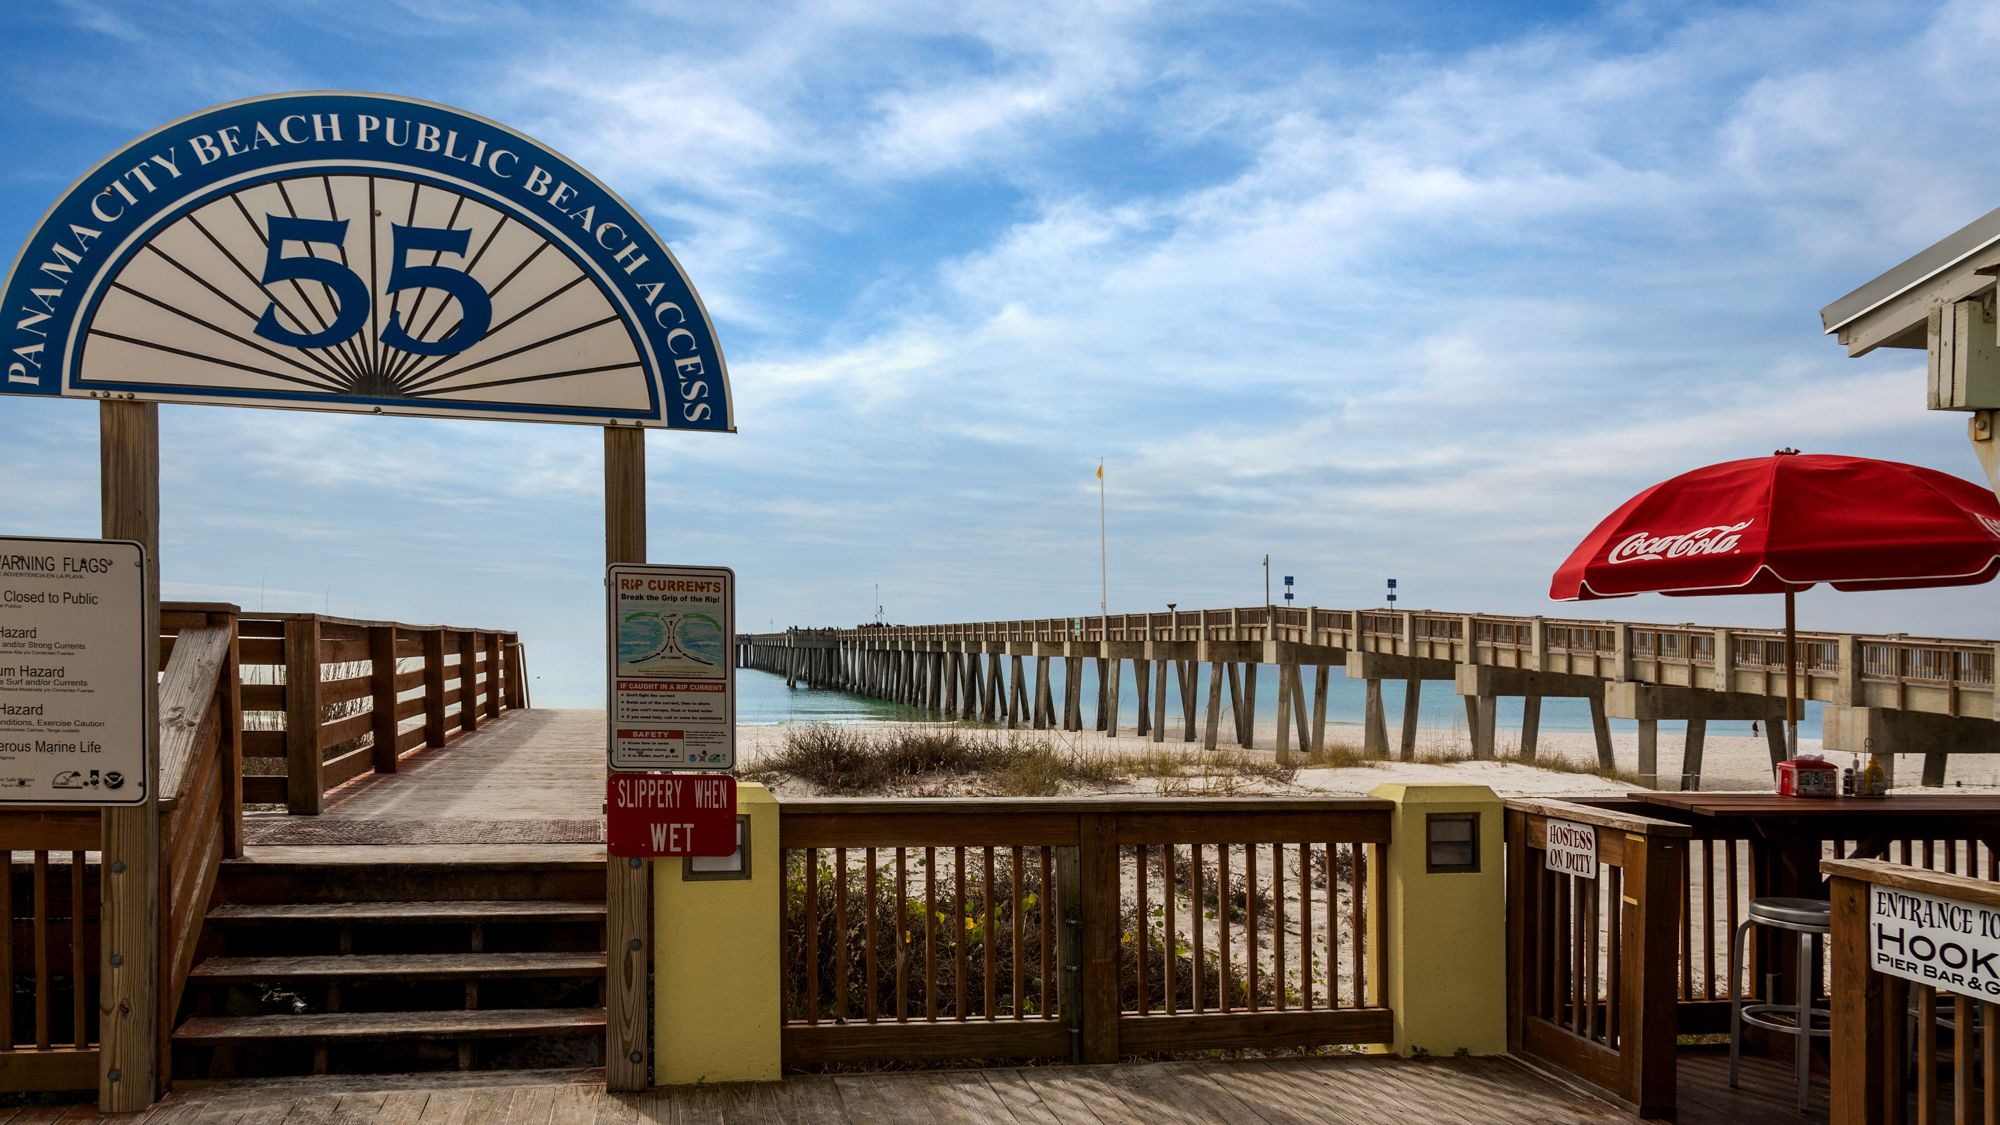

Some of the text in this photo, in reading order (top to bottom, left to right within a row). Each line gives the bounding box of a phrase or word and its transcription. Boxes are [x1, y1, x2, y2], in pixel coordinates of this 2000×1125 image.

[8, 113, 711, 424] PANAMA CITY BEACH PUBLIC BEACH ACCESS
[0, 554, 108, 574] ARNING FLAGS
[621, 579, 722, 593] RIP CURRENTS
[4, 590, 99, 605] Closed to Public
[661, 595, 678, 603] Grip
[705, 596, 720, 604] Rip!
[28, 641, 52, 650] Strong
[54, 642, 86, 650] Currents
[20, 665, 65, 678] Hazard
[6, 678, 23, 686] Surf
[25, 678, 51, 686] and/or
[53, 679, 88, 687] Currents
[37, 719, 71, 727] Exercise
[35, 740, 76, 753] Marine
[80, 741, 102, 753] Life
[618, 779, 727, 809] SLIPPERY WHEN
[650, 823, 695, 852] WET
[1549, 824, 1593, 851] HOSTESS
[1550, 848, 1592, 874] ON DUTY
[1876, 891, 2000, 940] ENTRANCE TO
[1877, 952, 1918, 974] PIER
[1924, 964, 1965, 986] BAR
[1968, 976, 1982, 991] &
